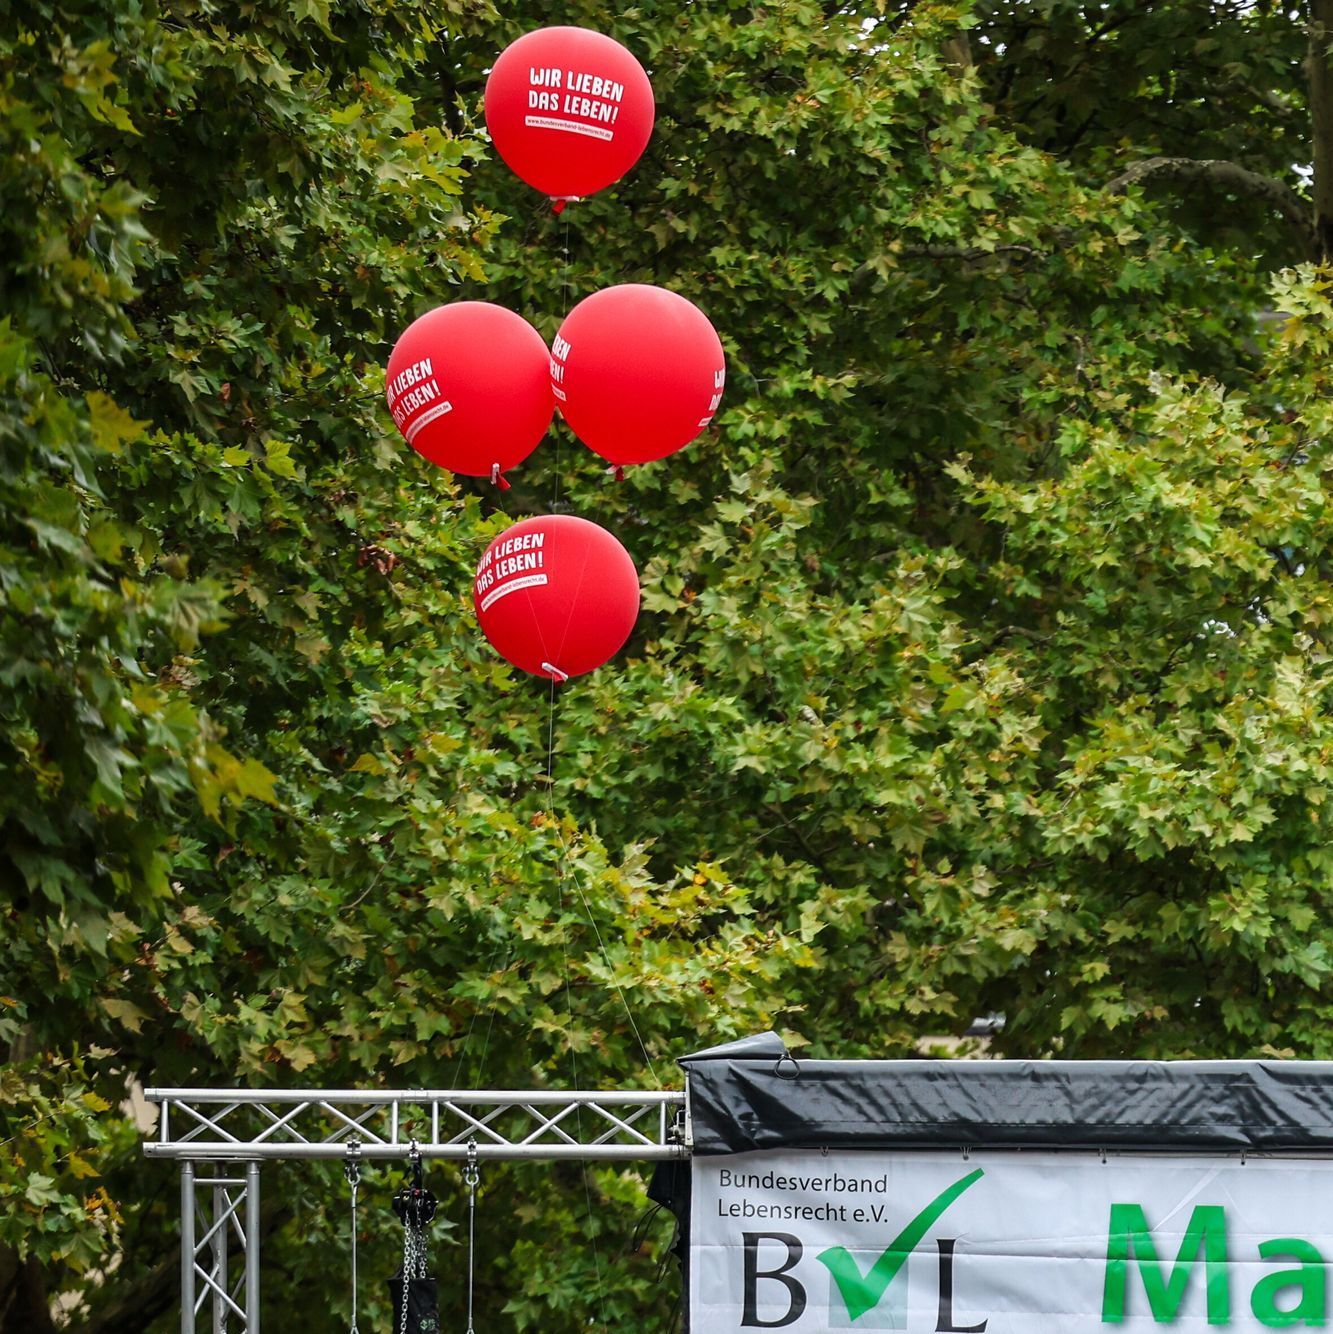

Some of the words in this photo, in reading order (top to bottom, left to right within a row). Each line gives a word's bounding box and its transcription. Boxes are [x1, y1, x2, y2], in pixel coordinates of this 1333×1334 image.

[530, 67, 562, 88] WIR
[566, 71, 624, 102] LIEBEN
[528, 90, 559, 111] DAS
[563, 94, 619, 125] LEBEN!
[393, 357, 433, 396] LIEBEN
[401, 379, 442, 416] LEBEN!
[495, 532, 545, 560] LIEBEN
[476, 568, 494, 595] DAS
[496, 551, 543, 580] LEBEN!
[719, 1168, 888, 1194] Bundesverband
[718, 1198, 848, 1222] Lebensrecht
[853, 1204, 889, 1223] e.V.
